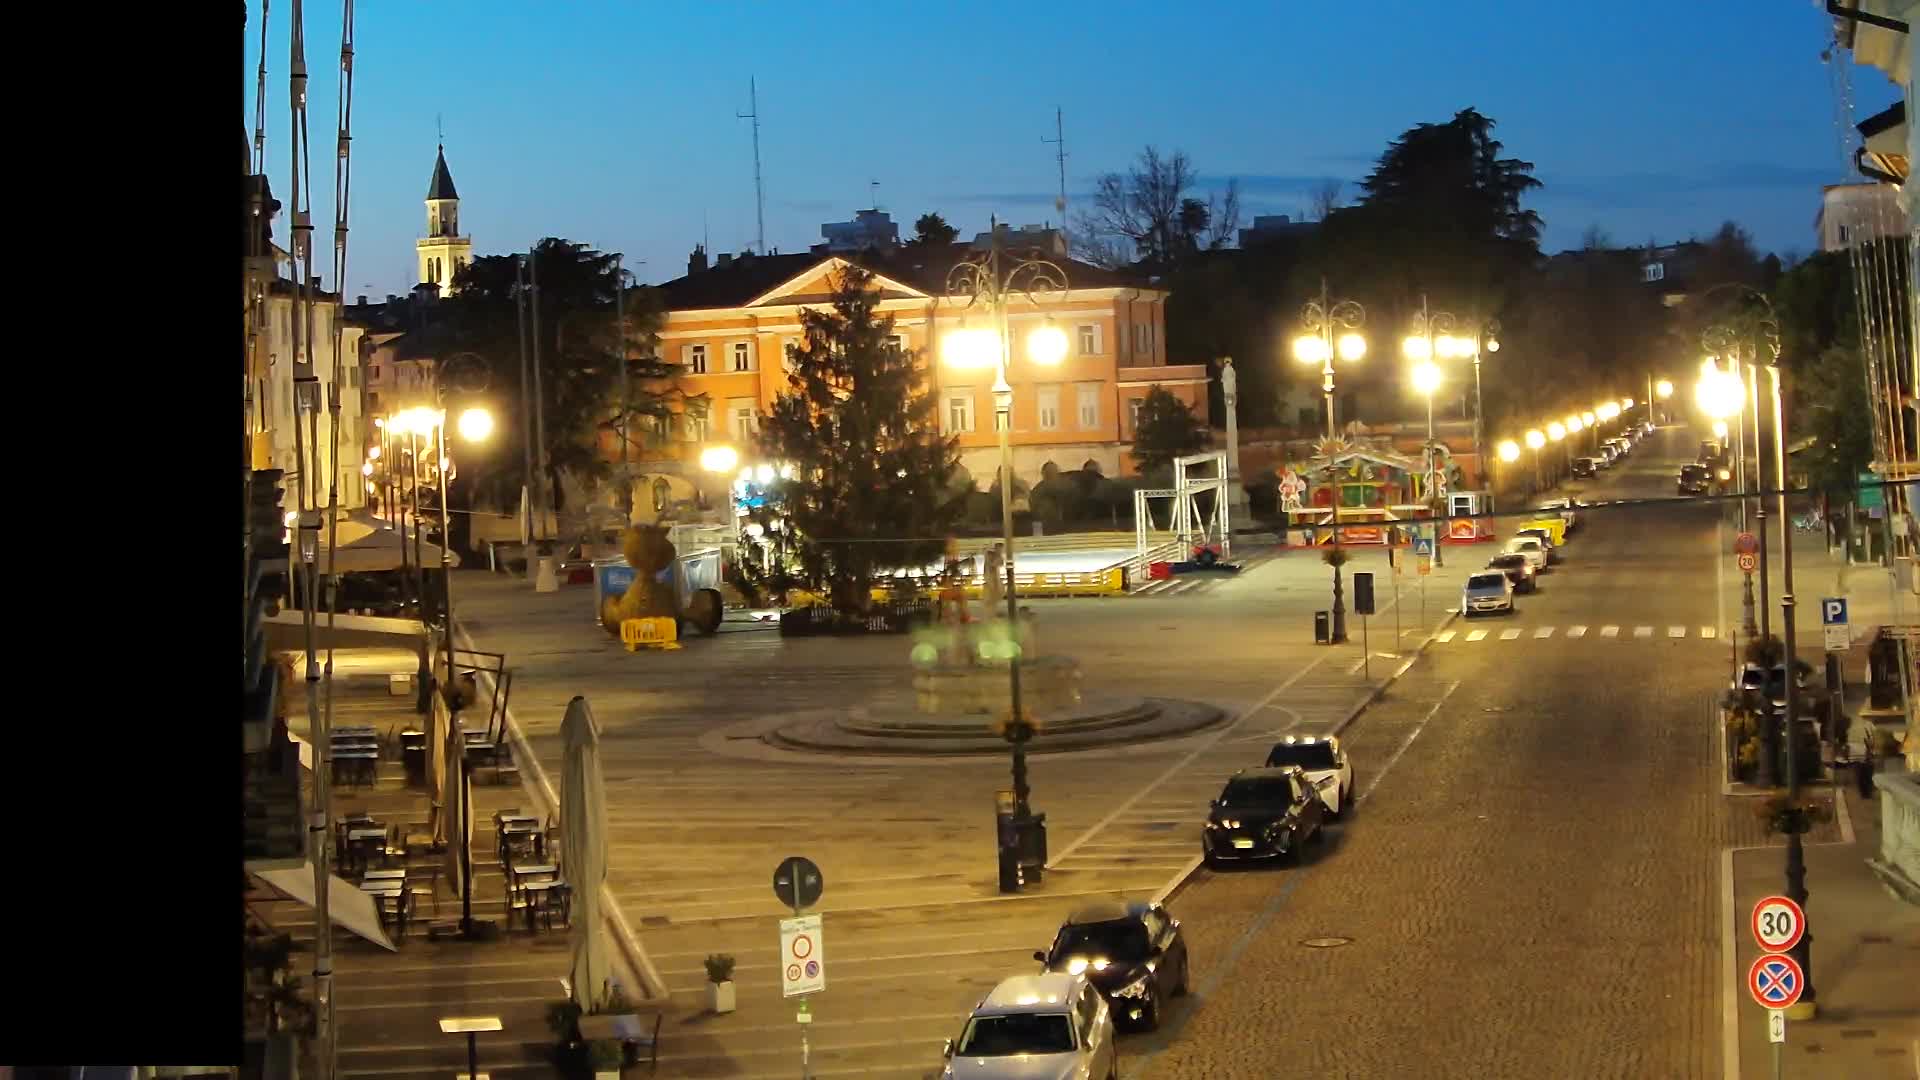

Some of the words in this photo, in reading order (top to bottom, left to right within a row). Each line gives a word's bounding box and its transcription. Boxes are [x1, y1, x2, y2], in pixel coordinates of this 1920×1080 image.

[1742, 557, 1753, 566] 20
[1827, 602, 1842, 621] P
[1762, 911, 1792, 937] 30
